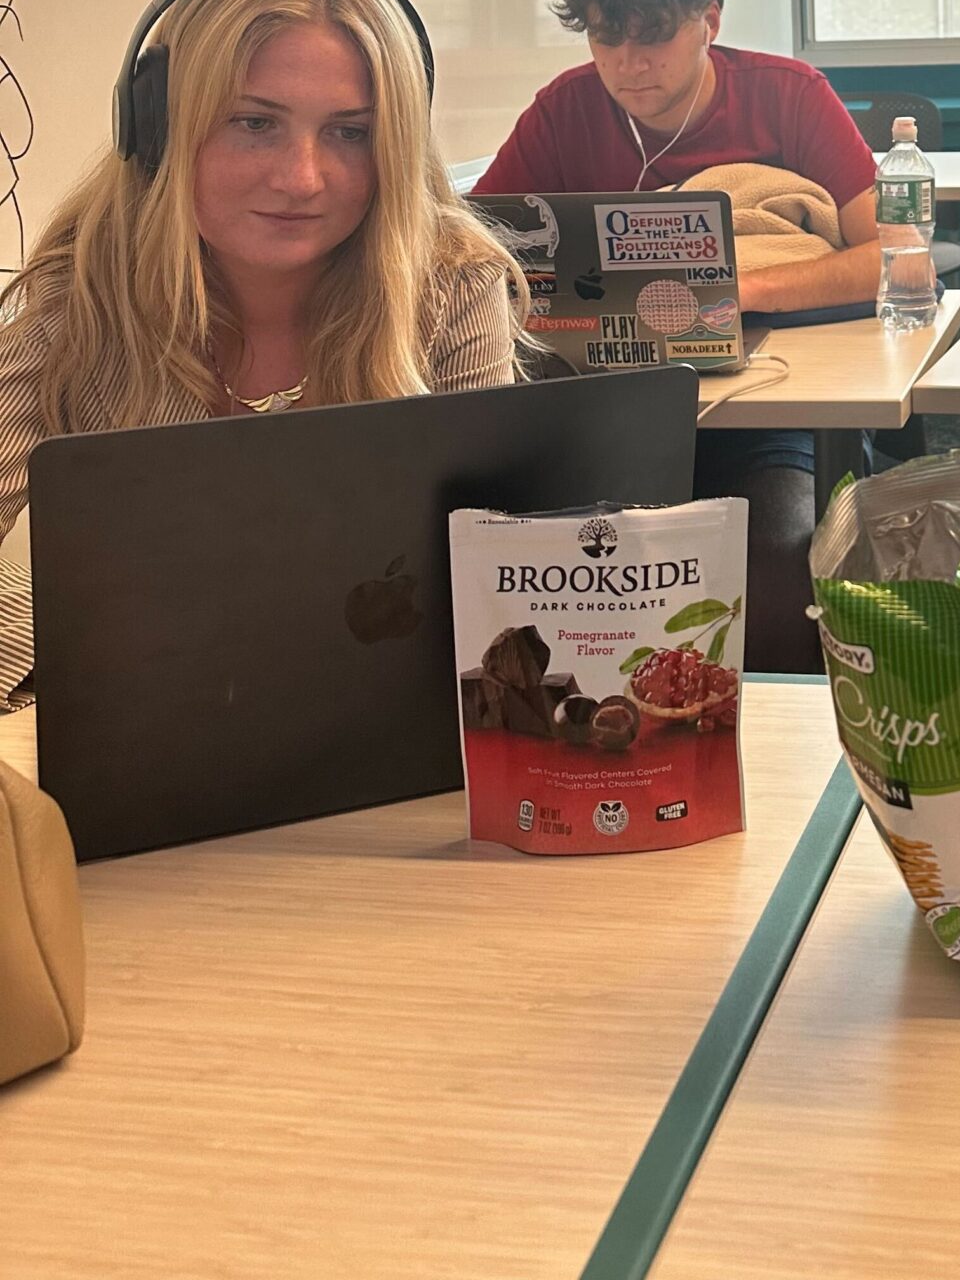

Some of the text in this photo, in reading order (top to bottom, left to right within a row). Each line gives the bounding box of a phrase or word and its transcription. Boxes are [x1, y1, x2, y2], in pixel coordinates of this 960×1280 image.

[630, 217, 683, 228] DEFUND
[645, 229, 670, 239] THE
[616, 240, 703, 252] POLITICIANS
[687, 266, 733, 280] IKON
[602, 316, 637, 340] PLAY
[587, 341, 658, 365] RENEGADE
[672, 344, 725, 354] NOBADEER
[496, 558, 700, 597] BROOKSIDE
[530, 598, 666, 611] DARK CHOCOLATE
[557, 629, 636, 643] Pomegranate
[577, 644, 616, 656] Flavor
[834, 675, 940, 763] Crisps
[561, 771, 599, 780] Flavored
[600, 769, 635, 780] Centers
[636, 763, 672, 777] Covered
[585, 781, 605, 790] Dark
[607, 778, 653, 789] Chocolate
[658, 802, 685, 815] GLUTEN
[663, 810, 682, 820] FREE
[604, 814, 618, 823] NO
